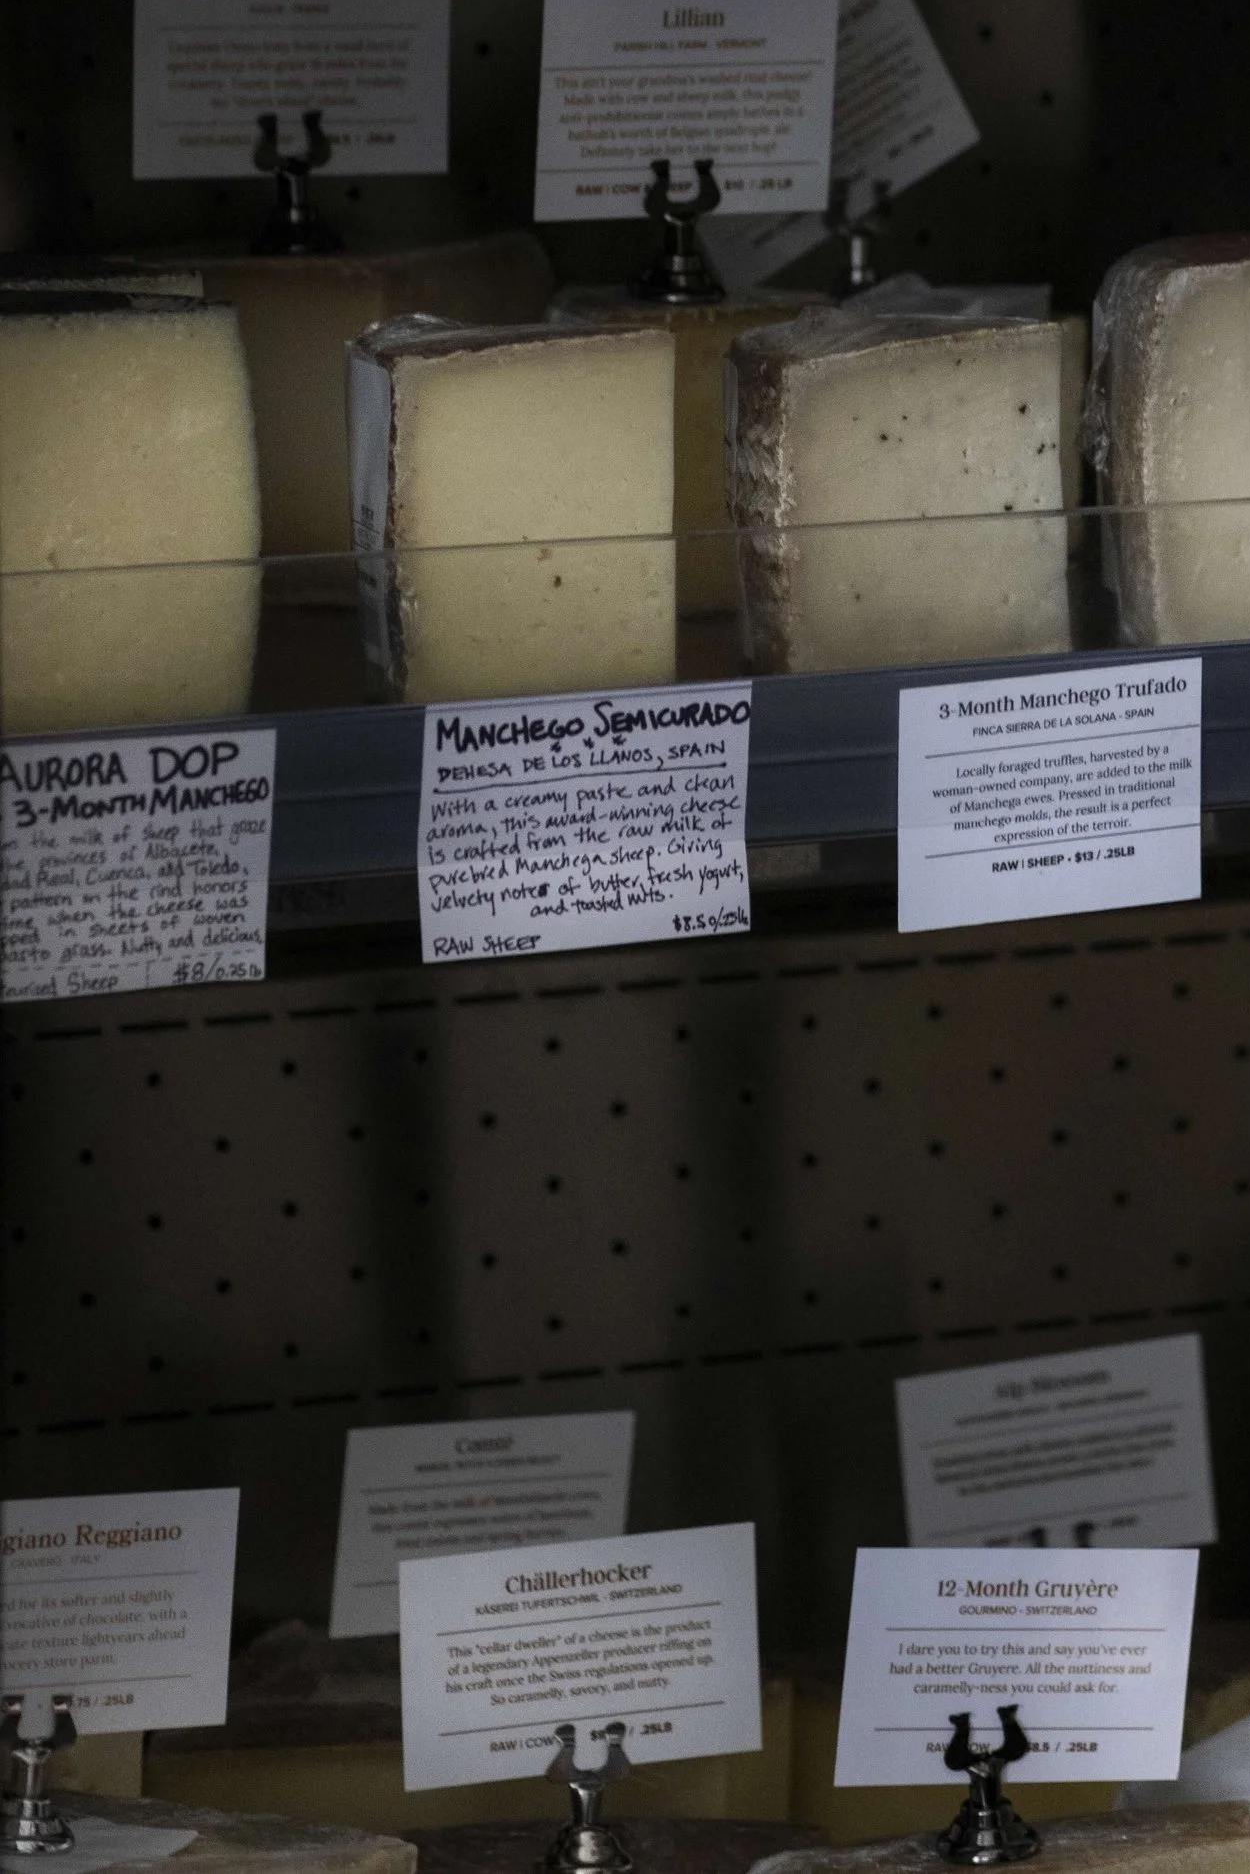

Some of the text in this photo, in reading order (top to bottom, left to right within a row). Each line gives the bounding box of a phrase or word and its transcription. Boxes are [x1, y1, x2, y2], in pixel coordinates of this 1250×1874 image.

[662, 8, 725, 30] Lillian
[939, 676, 1187, 719] 3-Month Manchego Trufado
[436, 701, 751, 752] MANCHEGO SEMICURADO
[973, 708, 1154, 736] FINCA SIERRA DE LA SOLANA SPAIN
[0, 741, 240, 794] AURORA DOP
[437, 740, 725, 783] DEHESA DE LOS LLANOS, SPAIN
[956, 746, 1169, 778] Locally foraged truffles, harvested by a
[932, 758, 1192, 798] woman-owned company, are added to the milk
[13, 777, 270, 828] 3-MONTH MANCHEGO
[432, 774, 734, 822] With a creamy paste and clean
[992, 846, 1135, 872] RAW SHEEP $13 .25LB
[434, 935, 541, 956] RAW SHEEP
[75, 1523, 182, 1548] Reggiano
[505, 1564, 652, 1594] Chällerhocker
[938, 1579, 1118, 1601] 12-Month Gruyère
[959, 1606, 1097, 1615] GOURMINO SWITZERLAND
[899, 1643, 1146, 1658] I dare you to try this and say you've ever
[890, 1662, 913, 1675] had
[916, 1665, 923, 1674] a
[926, 1662, 964, 1674] better
[1025, 1662, 1041, 1674] All
[1045, 1663, 1064, 1674] the
[1068, 1664, 1124, 1674] nuttiness
[1128, 1664, 1151, 1674] and
[914, 1681, 1119, 1696] caramelly-ness you could ask for.
